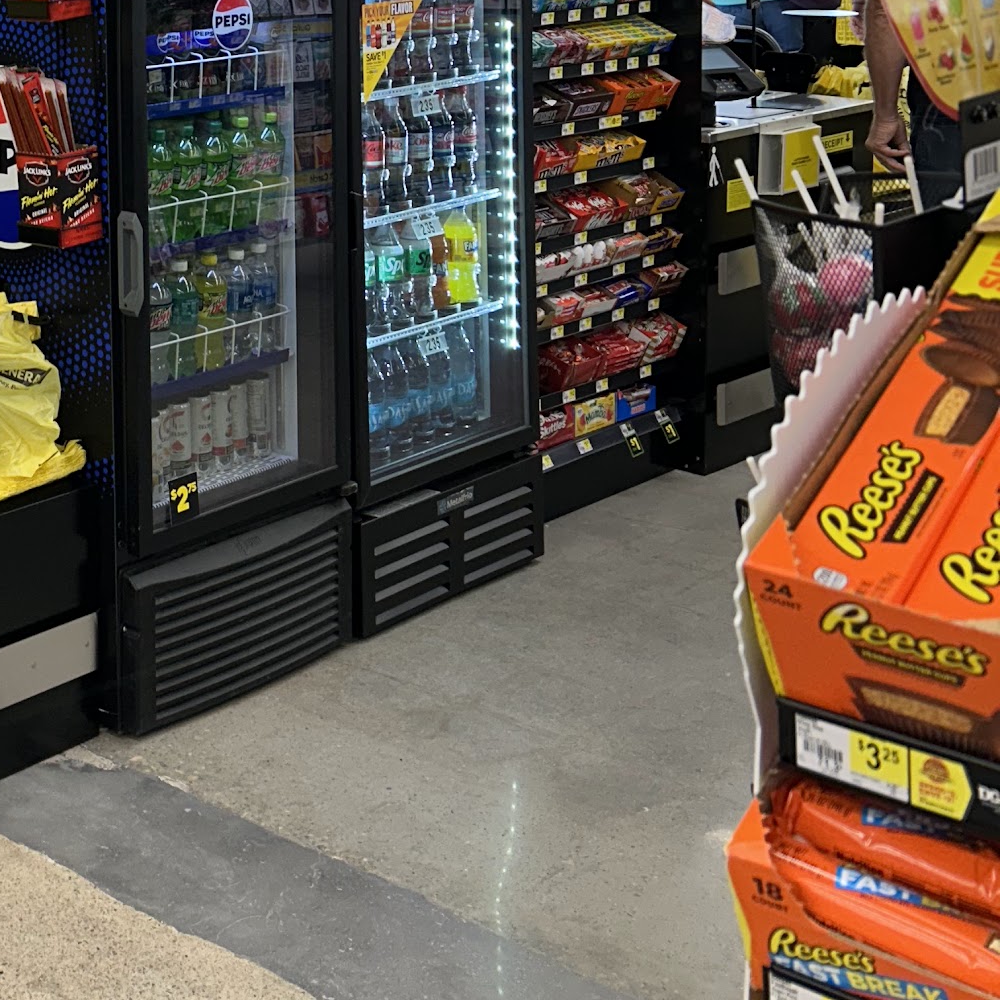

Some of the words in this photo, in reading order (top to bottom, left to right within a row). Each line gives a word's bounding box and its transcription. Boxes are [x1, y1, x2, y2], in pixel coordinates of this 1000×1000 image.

[391, 2, 413, 14] FLAVOR
[215, 13, 251, 29] PEPSI
[366, 51, 381, 62] SAVE
[419, 99, 433, 112] 235
[421, 222, 435, 235] 235
[819, 441, 923, 559] Reese's
[762, 579, 793, 598] 24
[761, 594, 802, 611] COUNT
[820, 603, 988, 676] Reese's
[752, 876, 784, 902] 18
[838, 870, 912, 902] FAST
[770, 928, 876, 974] Reese's
